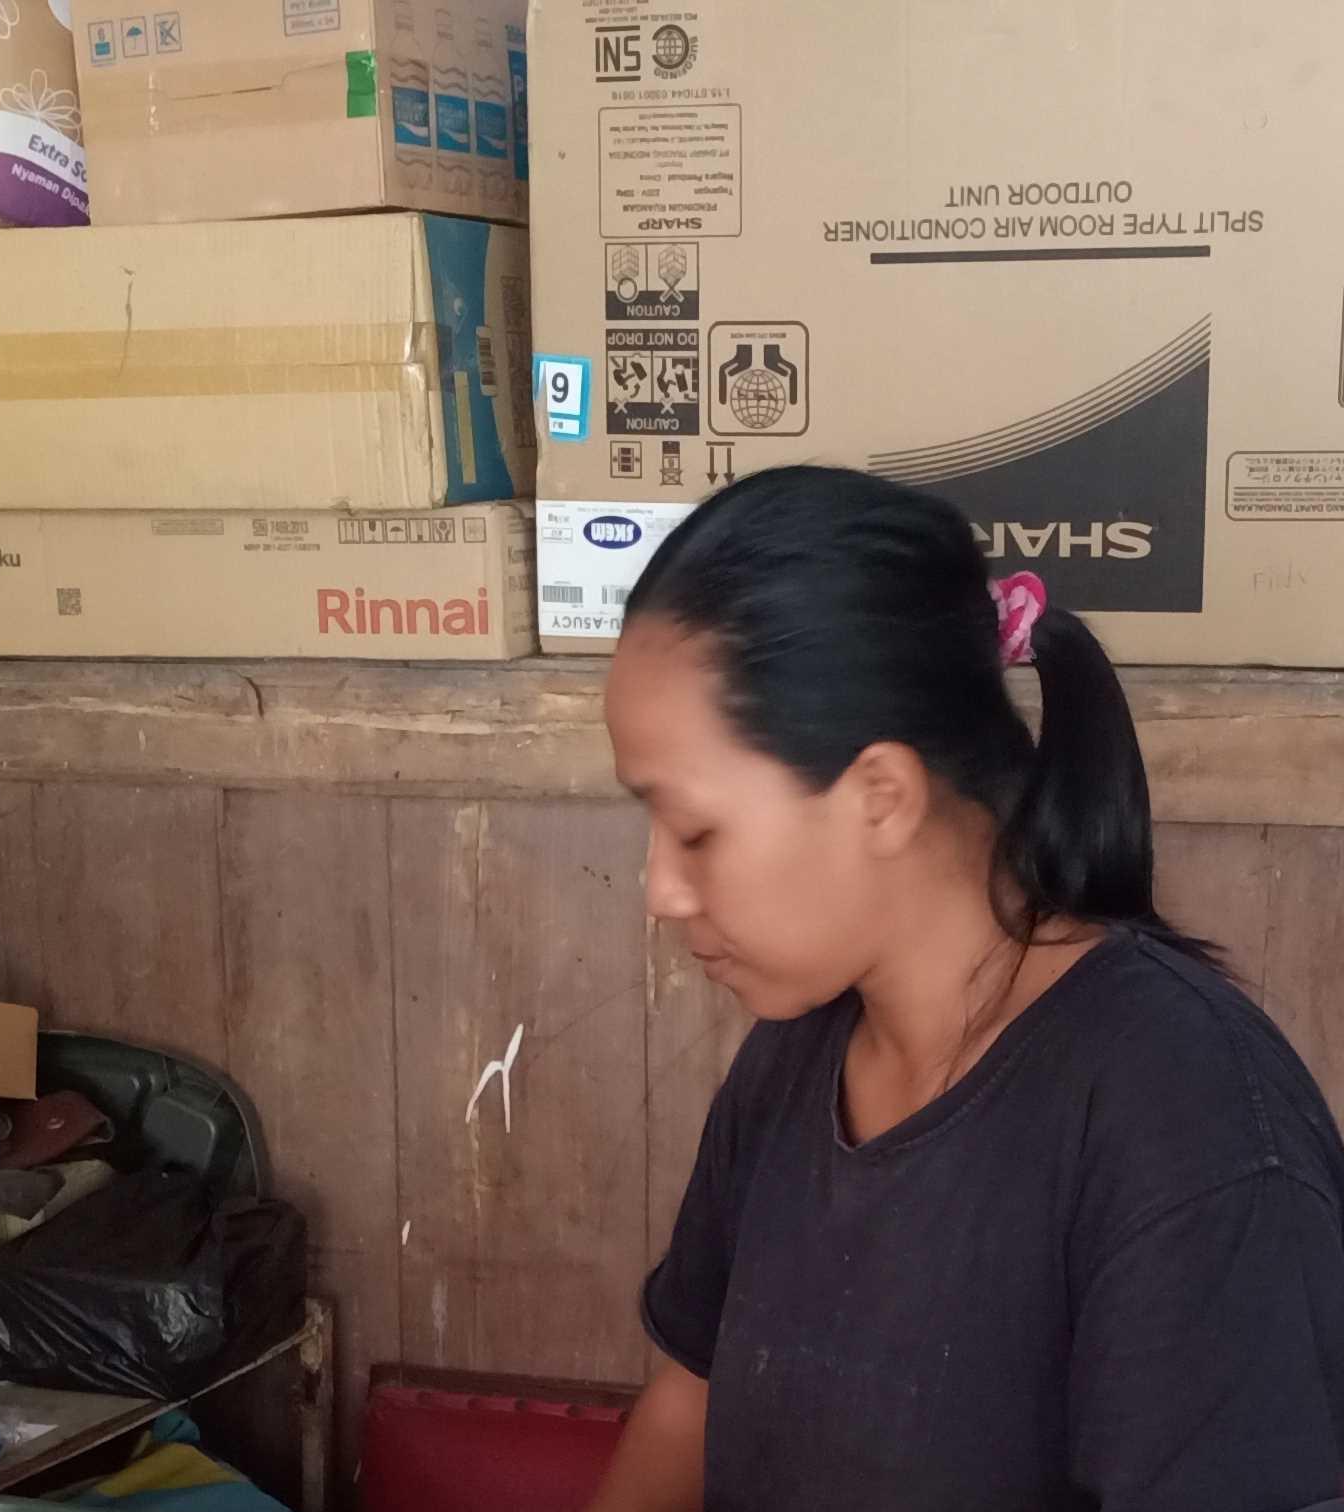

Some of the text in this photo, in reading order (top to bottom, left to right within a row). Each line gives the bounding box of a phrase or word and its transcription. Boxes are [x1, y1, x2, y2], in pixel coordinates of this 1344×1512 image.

[595, 35, 641, 72] SNI
[28, 134, 68, 168] Extra
[11, 163, 59, 196] Nyaman
[944, 180, 1133, 209] OUTDOOR UNIT
[638, 217, 702, 231] SHARP
[822, 209, 1264, 242] SPLIT TYPE ROOM AIR CONDITIONER
[626, 304, 680, 317] CAUTION
[607, 333, 697, 345] DO NOT DROP
[626, 418, 679, 431] CAUTION
[968, 521, 1153, 559] SHAR
[316, 587, 489, 635] Rinnai
[552, 615, 625, 630] U-A5UCY
